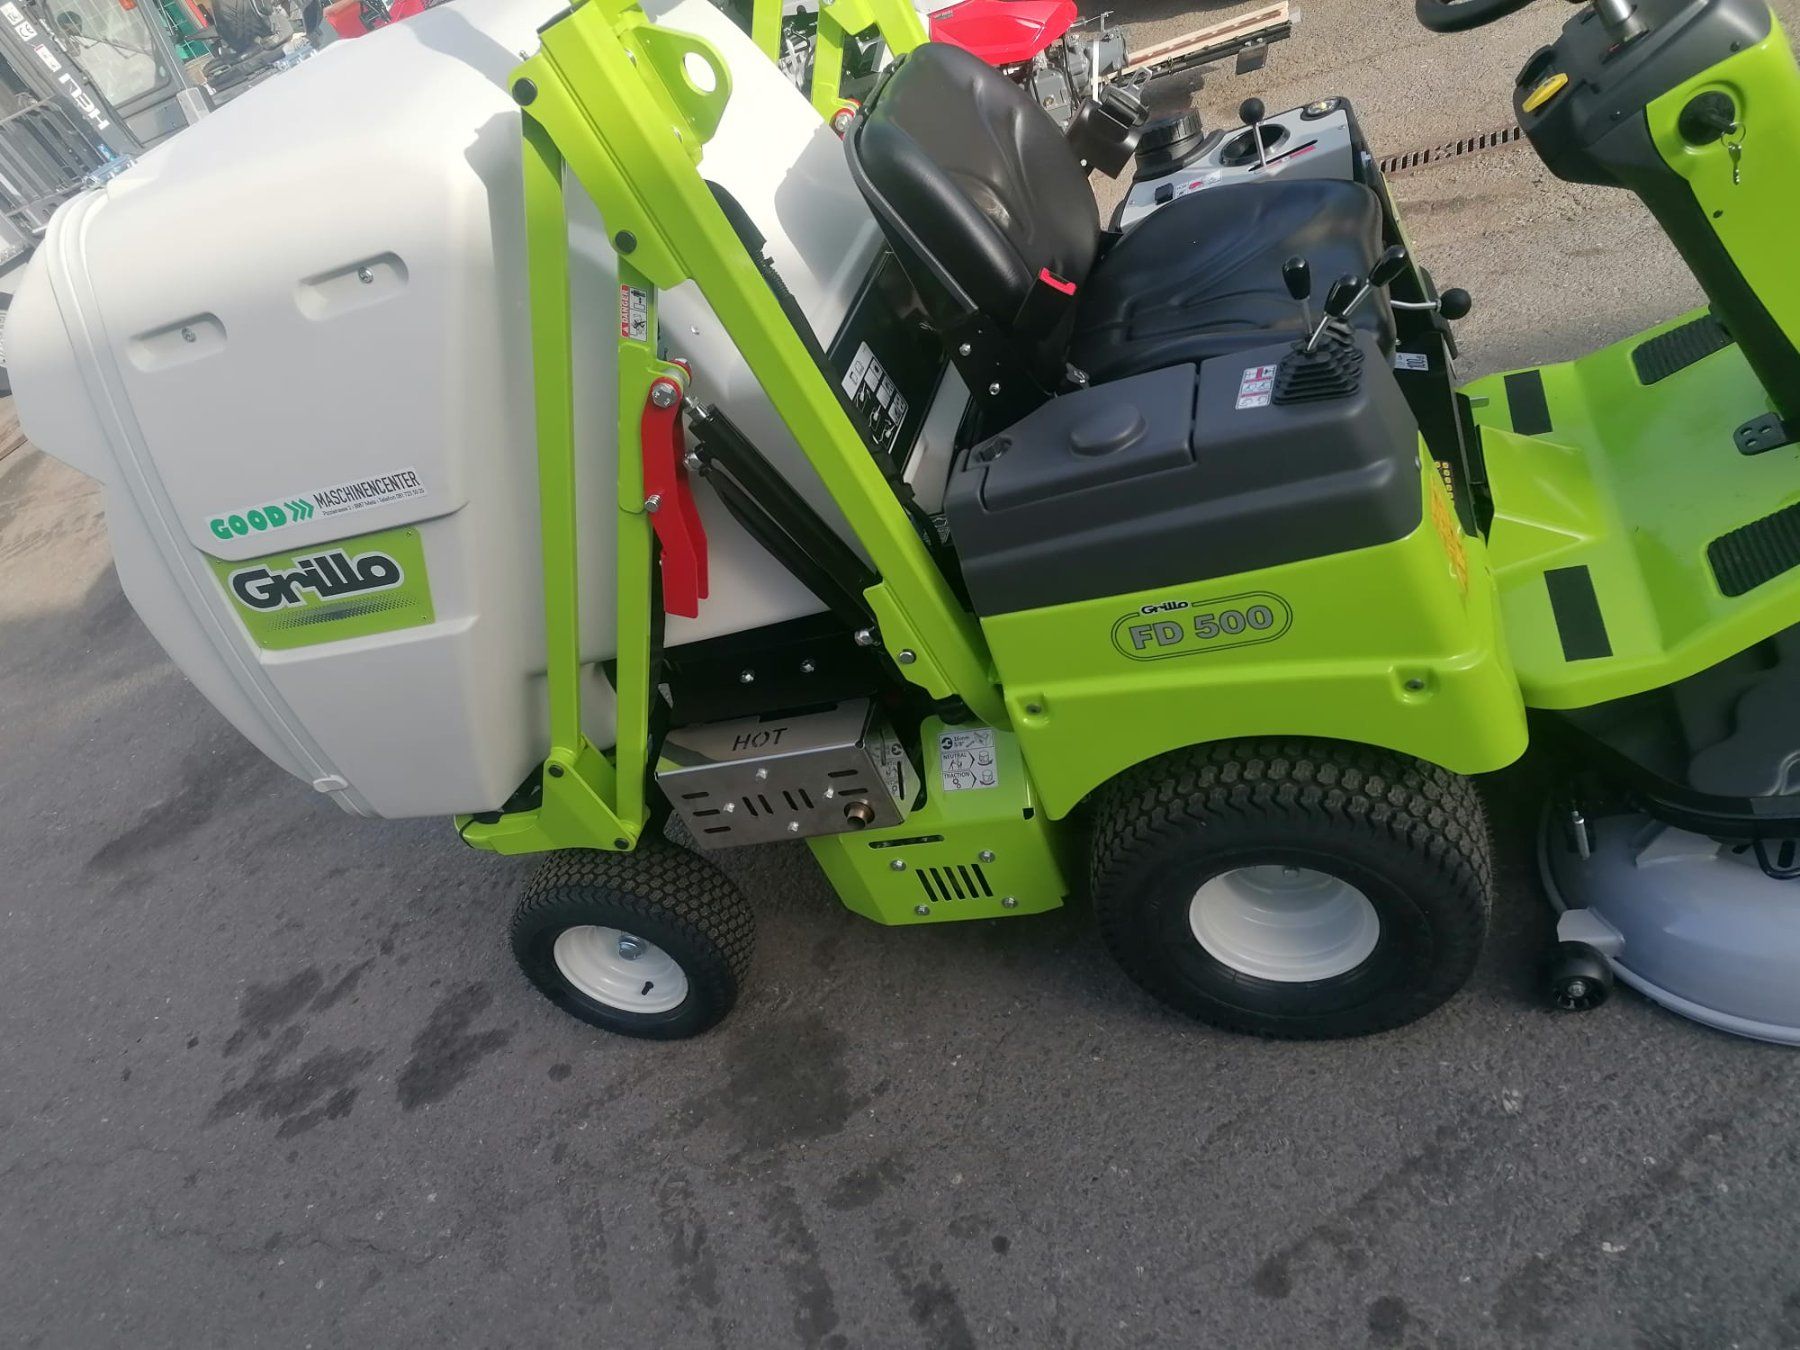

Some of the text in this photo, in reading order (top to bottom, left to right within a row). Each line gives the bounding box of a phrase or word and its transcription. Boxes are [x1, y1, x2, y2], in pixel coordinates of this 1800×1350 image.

[621, 289, 630, 322] DANGER
[313, 471, 420, 508] MASCHINENCENTER
[210, 505, 287, 540] GOOD
[230, 551, 402, 610] Grillo
[1140, 600, 1189, 615] Grillo
[1129, 604, 1274, 650] FD 500
[732, 727, 788, 751] HOT
